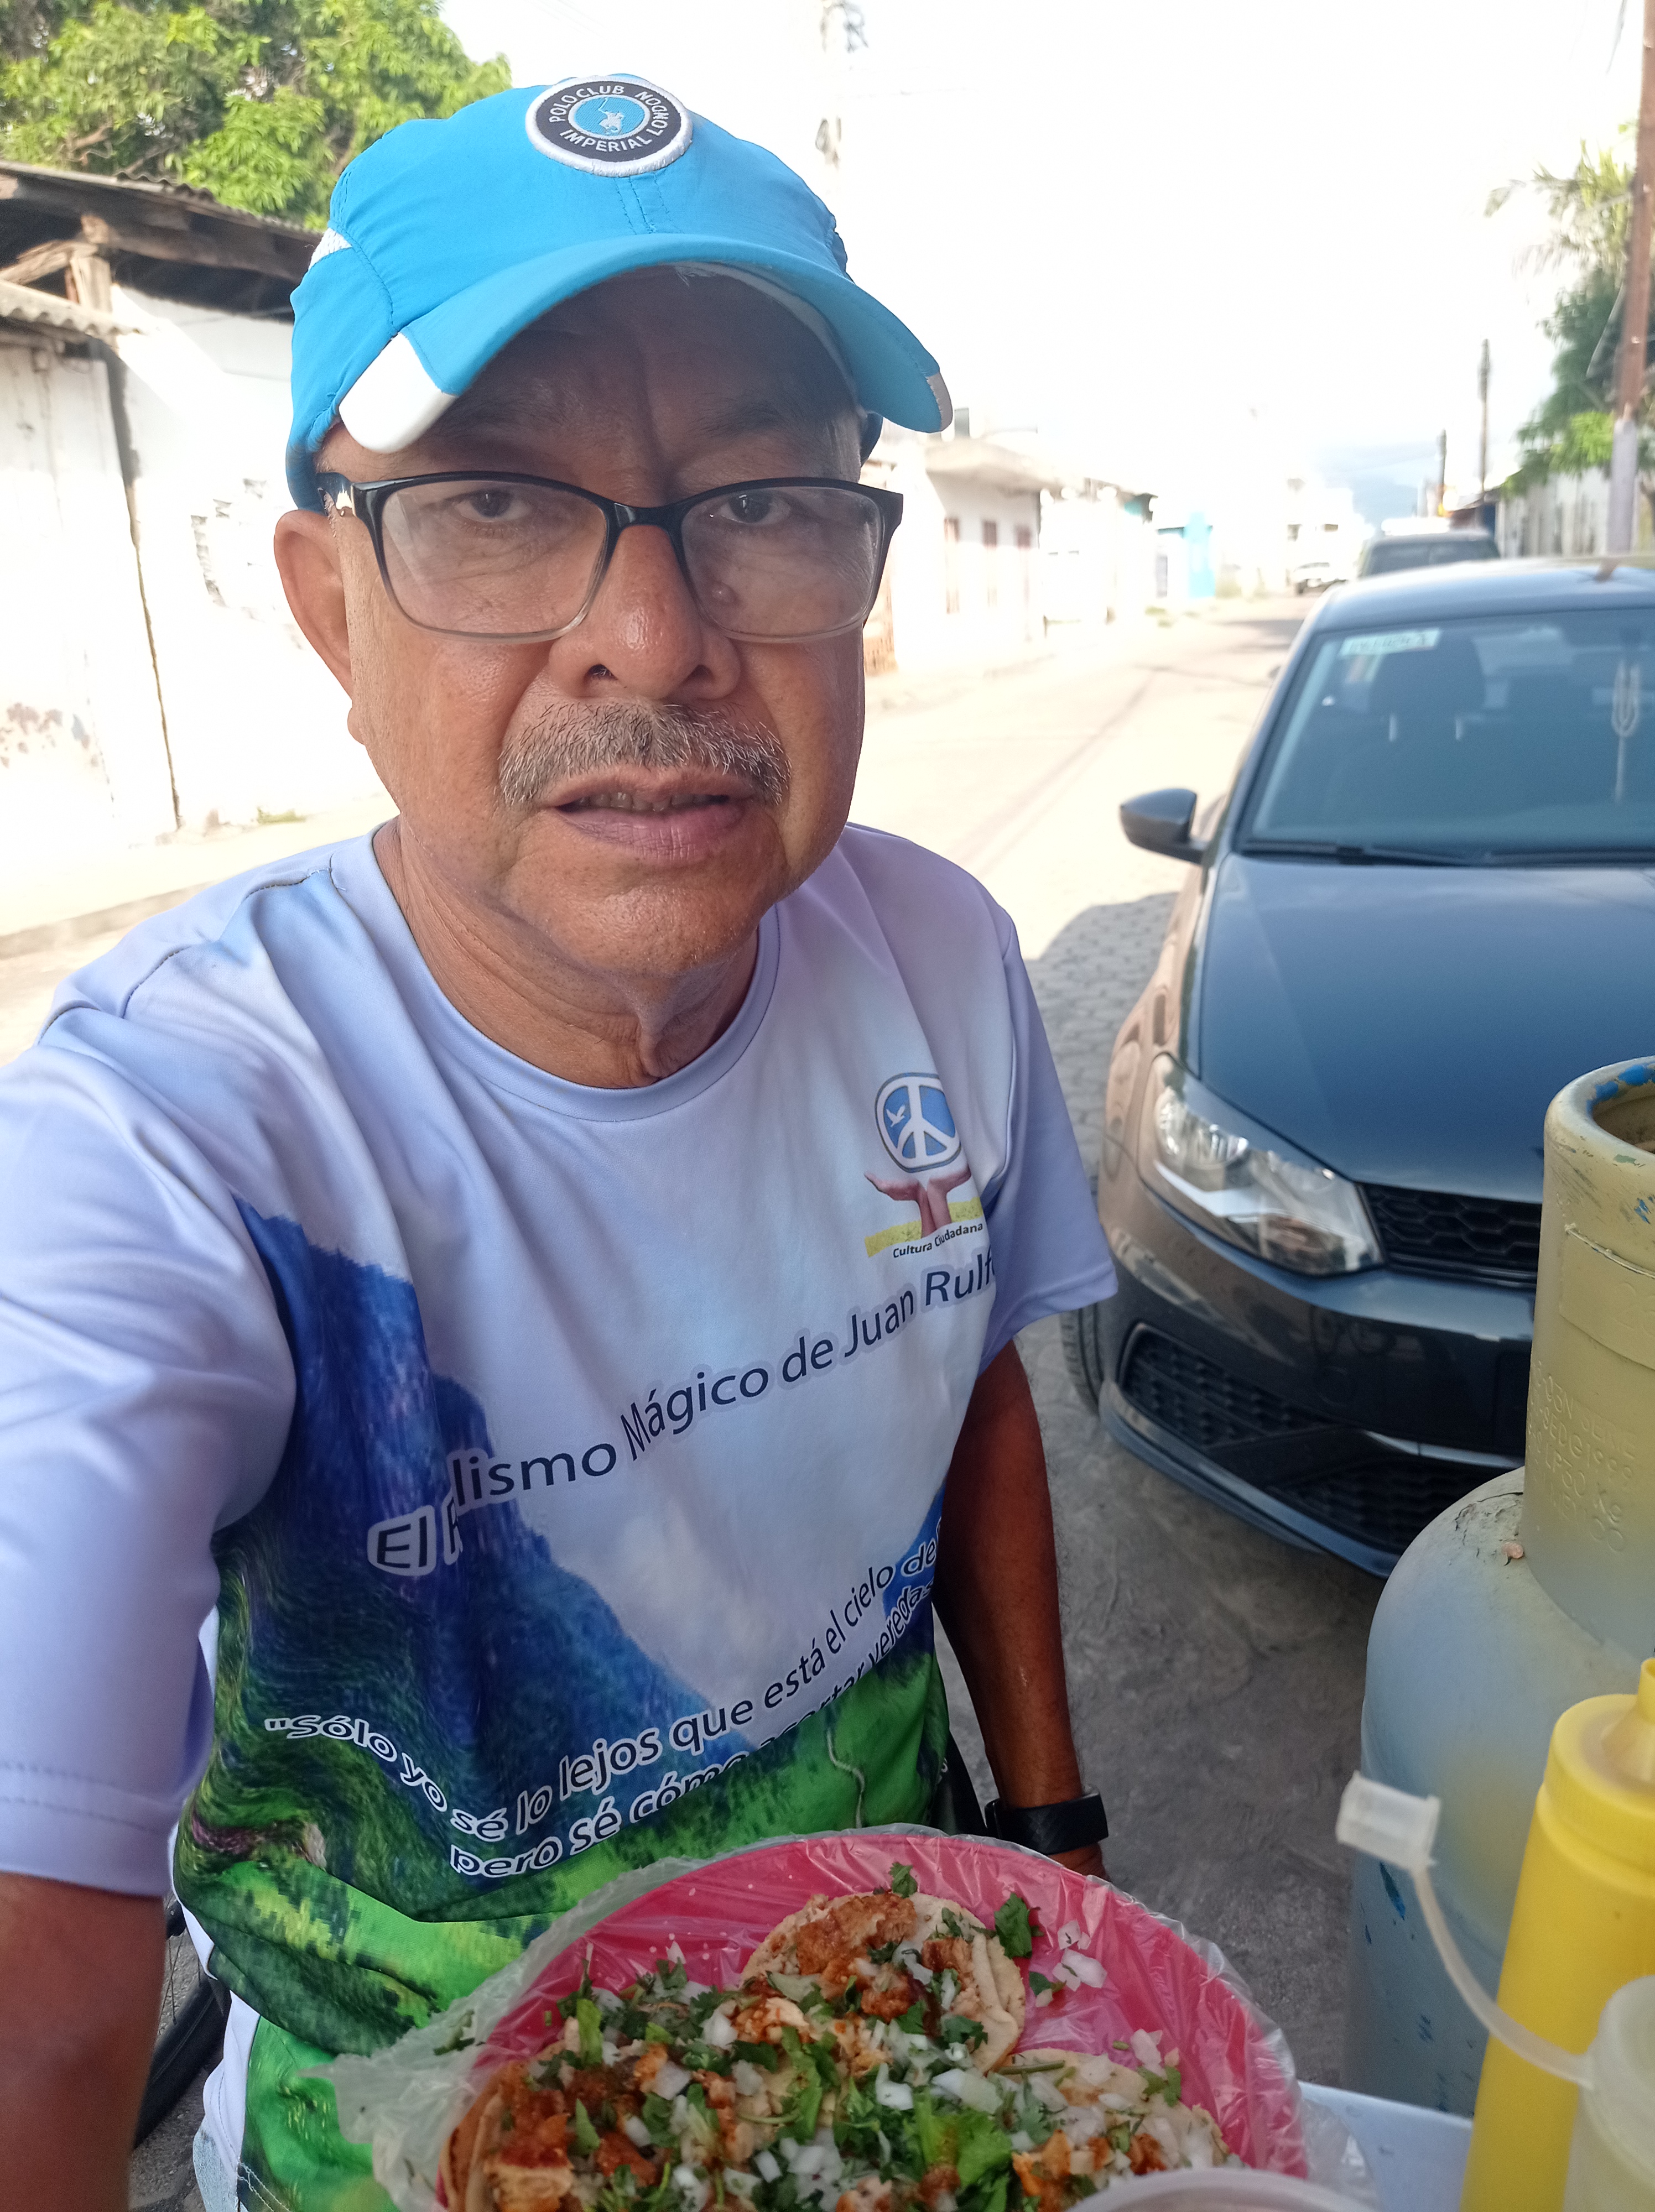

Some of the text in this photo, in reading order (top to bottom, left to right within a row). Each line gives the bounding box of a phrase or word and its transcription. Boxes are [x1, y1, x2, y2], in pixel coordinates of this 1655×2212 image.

[549, 85, 624, 123] POLO CLUB
[560, 91, 669, 152] IMPERIAL LONDON
[893, 1223, 983, 1258] Cultura Ciudadana
[377, 1515, 428, 1569] El
[446, 1442, 617, 1554] Rlismo
[620, 1367, 769, 1461] Mágico
[782, 1337, 833, 1383] de
[844, 1288, 914, 1358] Juan
[266, 1716, 397, 1762] "Sólo
[401, 1753, 447, 1812] yo
[451, 1808, 507, 1841] sé
[517, 1786, 552, 1834] lo
[560, 1728, 662, 1795] lejos
[672, 1700, 753, 1755] que
[764, 1637, 825, 1709] está
[826, 1610, 847, 1655] el
[844, 1566, 894, 1627] cielo
[901, 1538, 936, 1577] de
[450, 1836, 563, 1877] pero
[570, 1797, 622, 1855] sé
